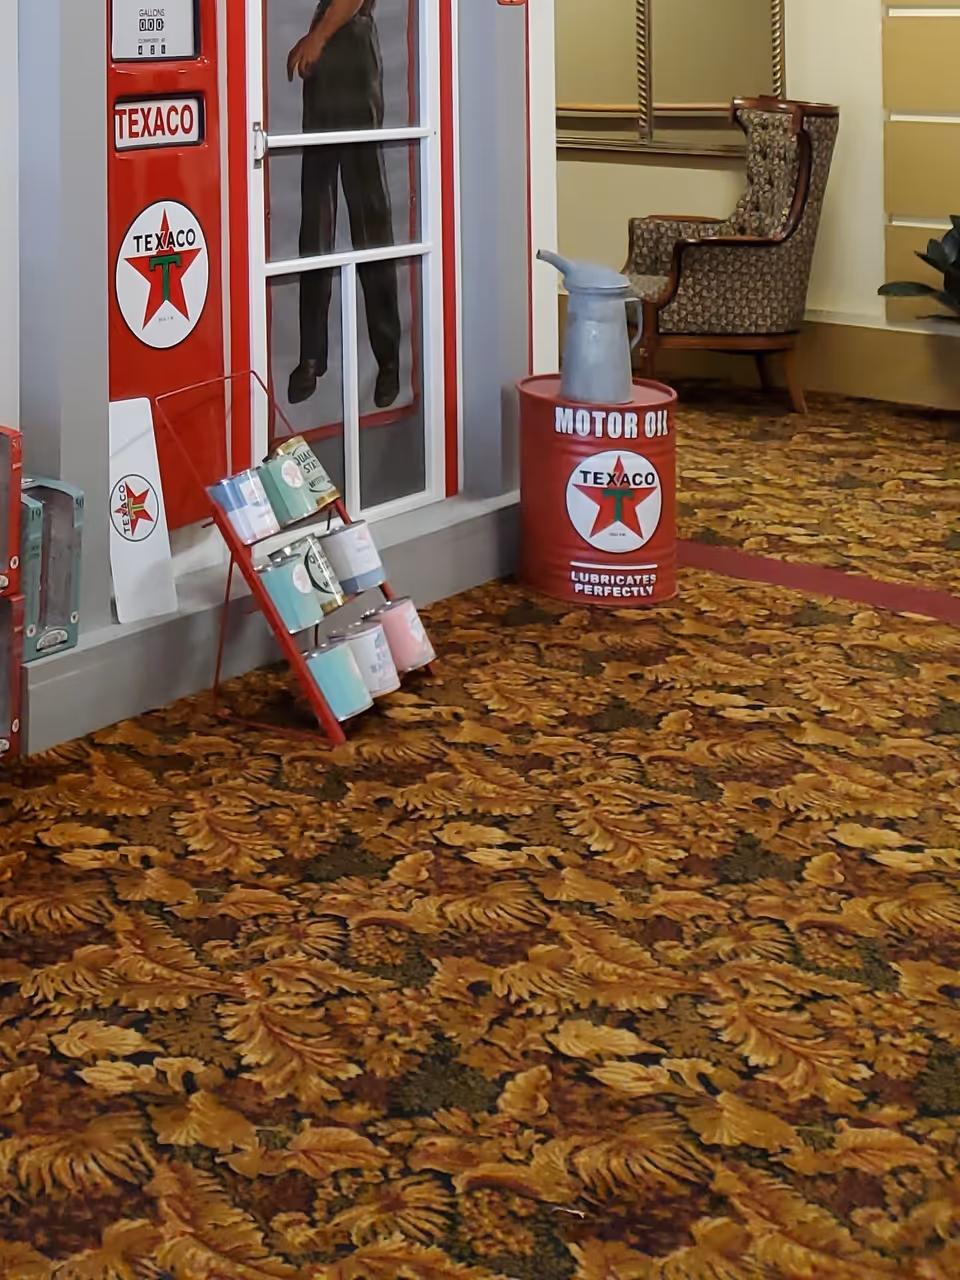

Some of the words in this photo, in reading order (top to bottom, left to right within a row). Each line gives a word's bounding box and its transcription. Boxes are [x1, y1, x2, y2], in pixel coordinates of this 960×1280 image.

[139, 9, 165, 17] GALLONS
[114, 104, 194, 140] TEXACO
[133, 228, 196, 253] TEXACO
[554, 406, 638, 438] MOTOR
[579, 470, 655, 486] TEXACO
[118, 484, 131, 534] TEXACO
[571, 571, 657, 585] LUBRICATES
[574, 584, 654, 597] PERFECTLY
